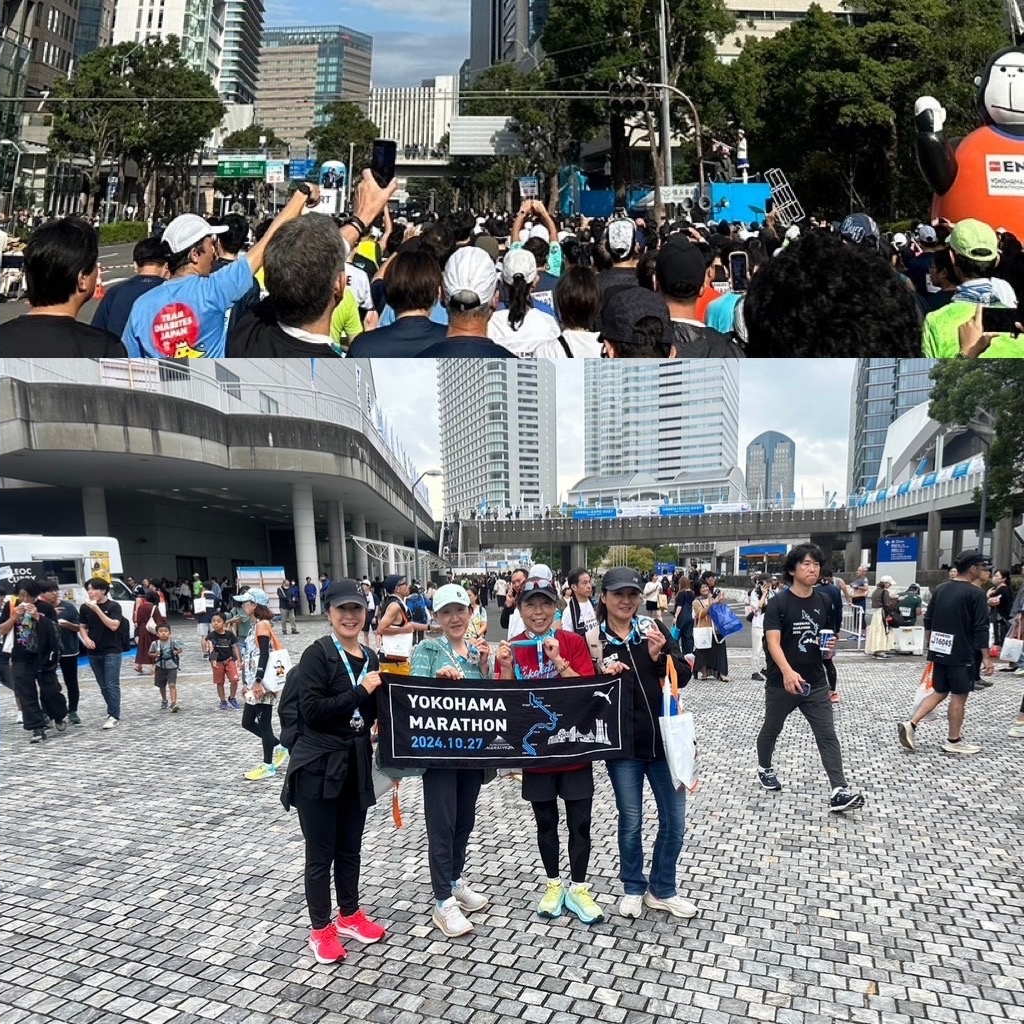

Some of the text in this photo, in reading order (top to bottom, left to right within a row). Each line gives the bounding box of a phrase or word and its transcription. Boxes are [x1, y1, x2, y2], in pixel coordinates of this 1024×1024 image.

[161, 310, 185, 322] TEAM
[153, 316, 193, 333] DIABETES
[160, 326, 188, 341] JAPAN
[407, 693, 507, 712] YOKOHAMA
[409, 715, 507, 732] MARATHON
[410, 735, 483, 750] 2024.10.27
